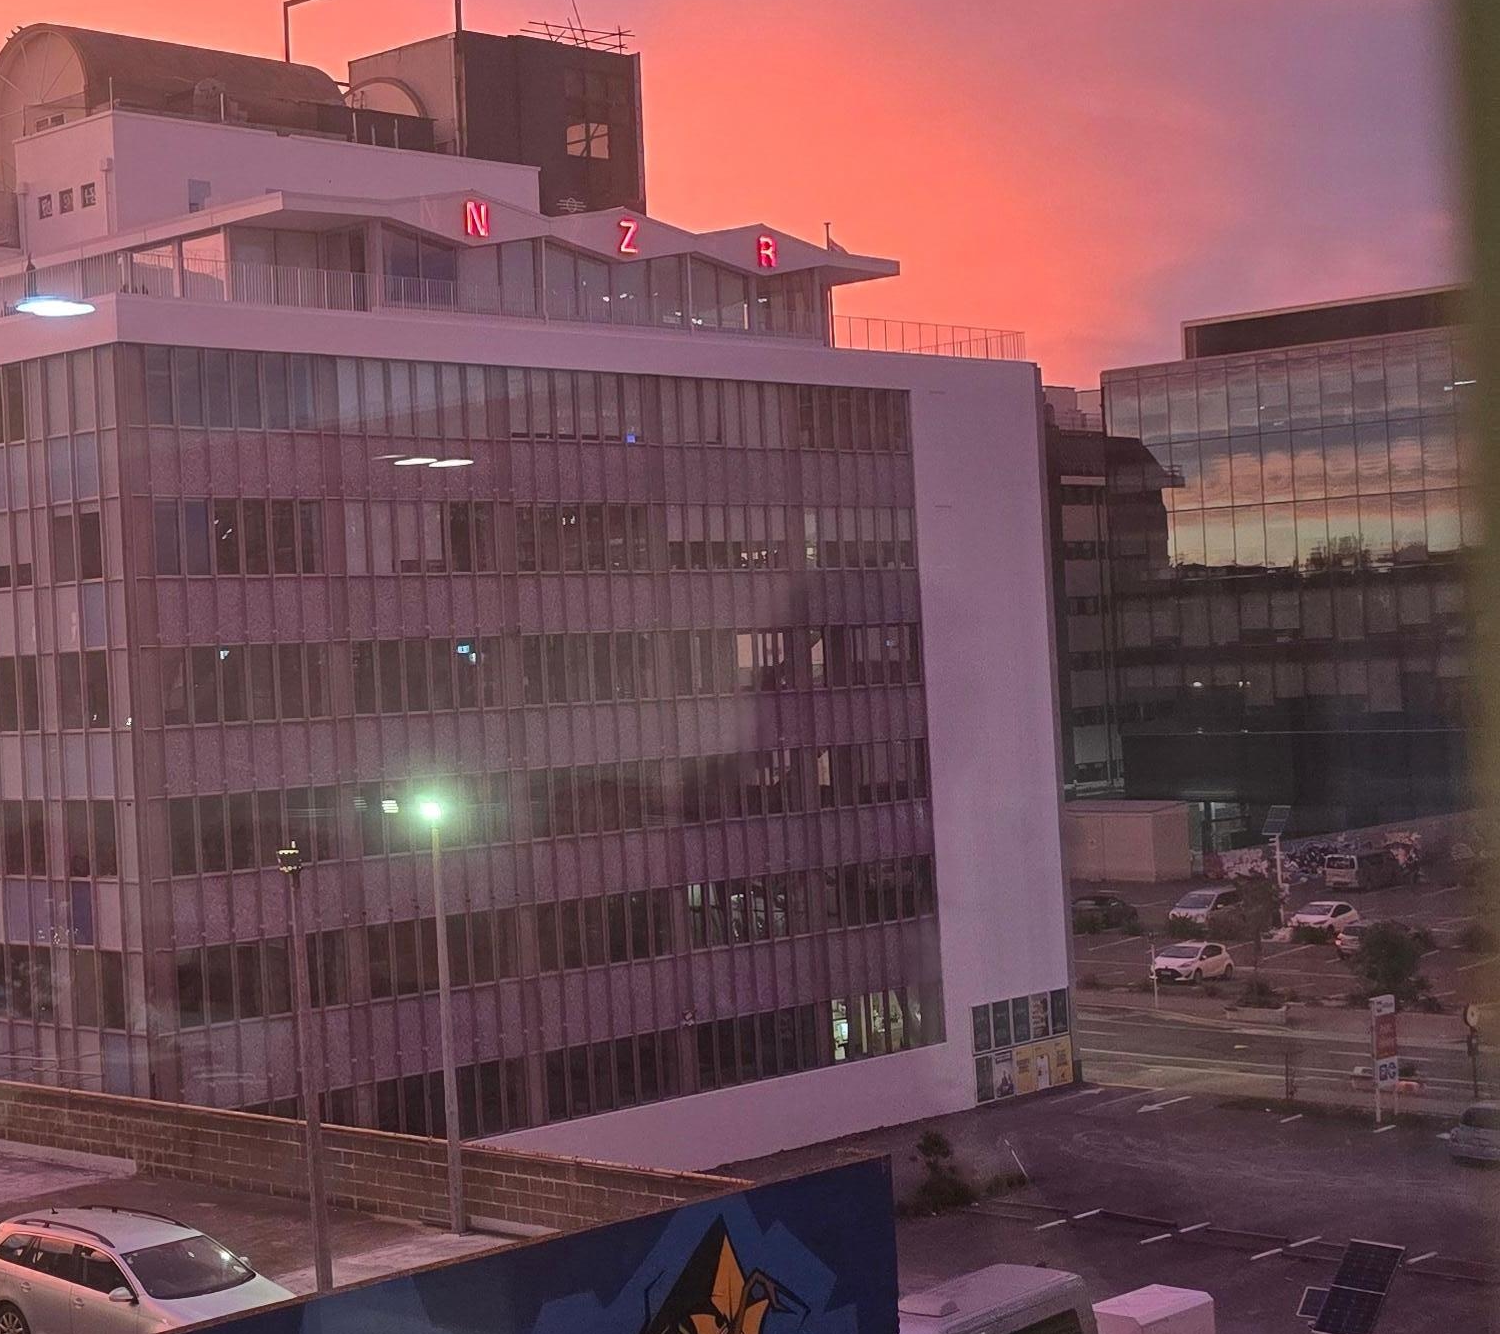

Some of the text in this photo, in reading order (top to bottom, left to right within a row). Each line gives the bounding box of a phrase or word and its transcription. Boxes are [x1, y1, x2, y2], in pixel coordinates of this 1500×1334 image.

[465, 201, 777, 267] N Z R
